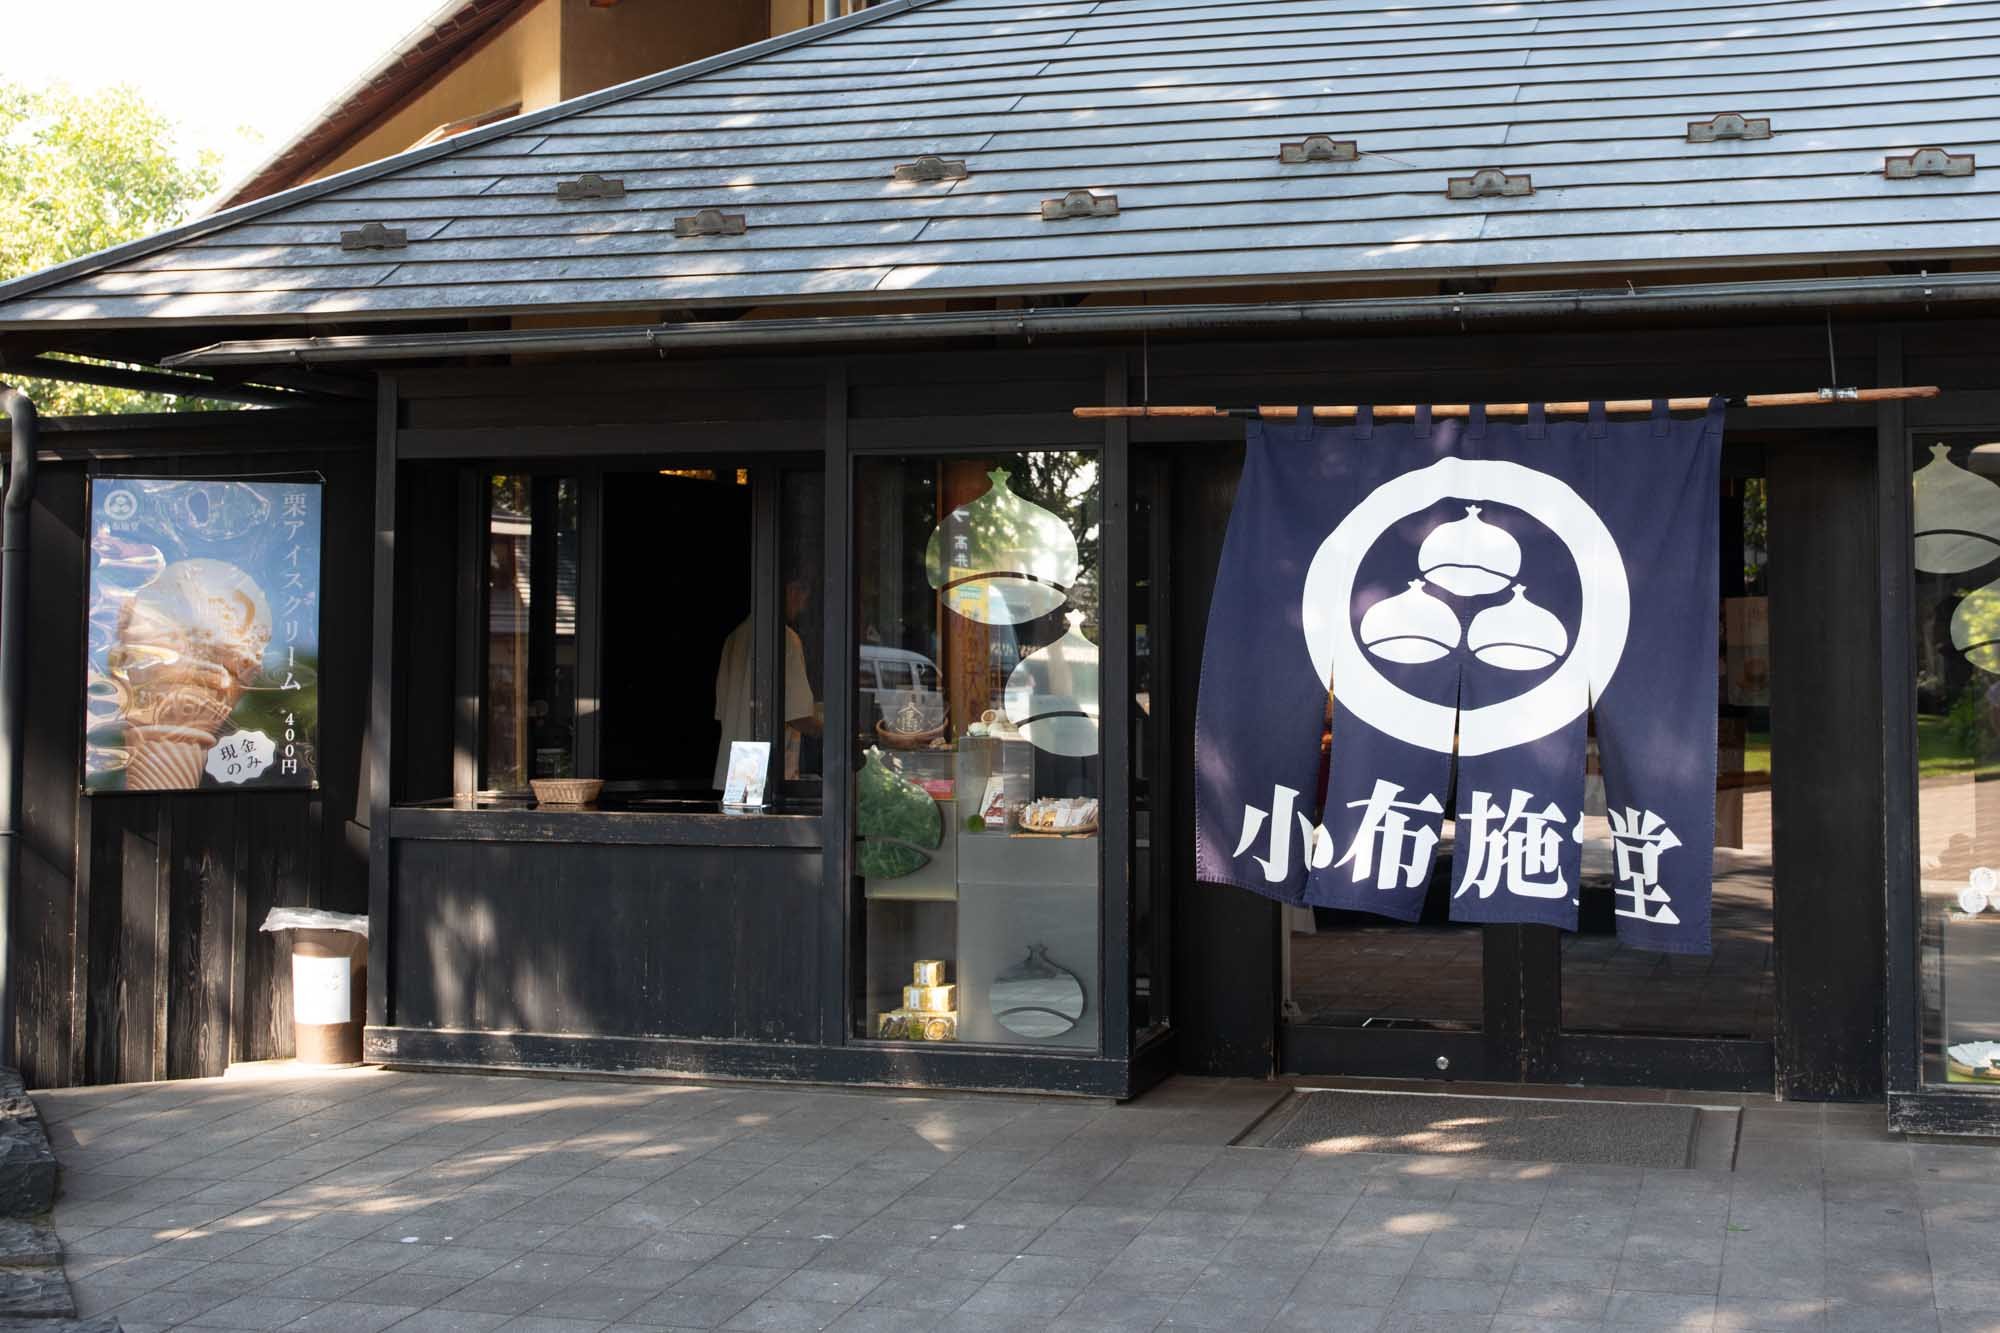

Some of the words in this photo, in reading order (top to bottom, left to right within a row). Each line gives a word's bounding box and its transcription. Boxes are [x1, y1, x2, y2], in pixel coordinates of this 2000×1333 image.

[281, 492, 306, 691] 栗アイスクリーム
[281, 712, 297, 775] 400円
[1233, 778, 1683, 925] 小布施堂
